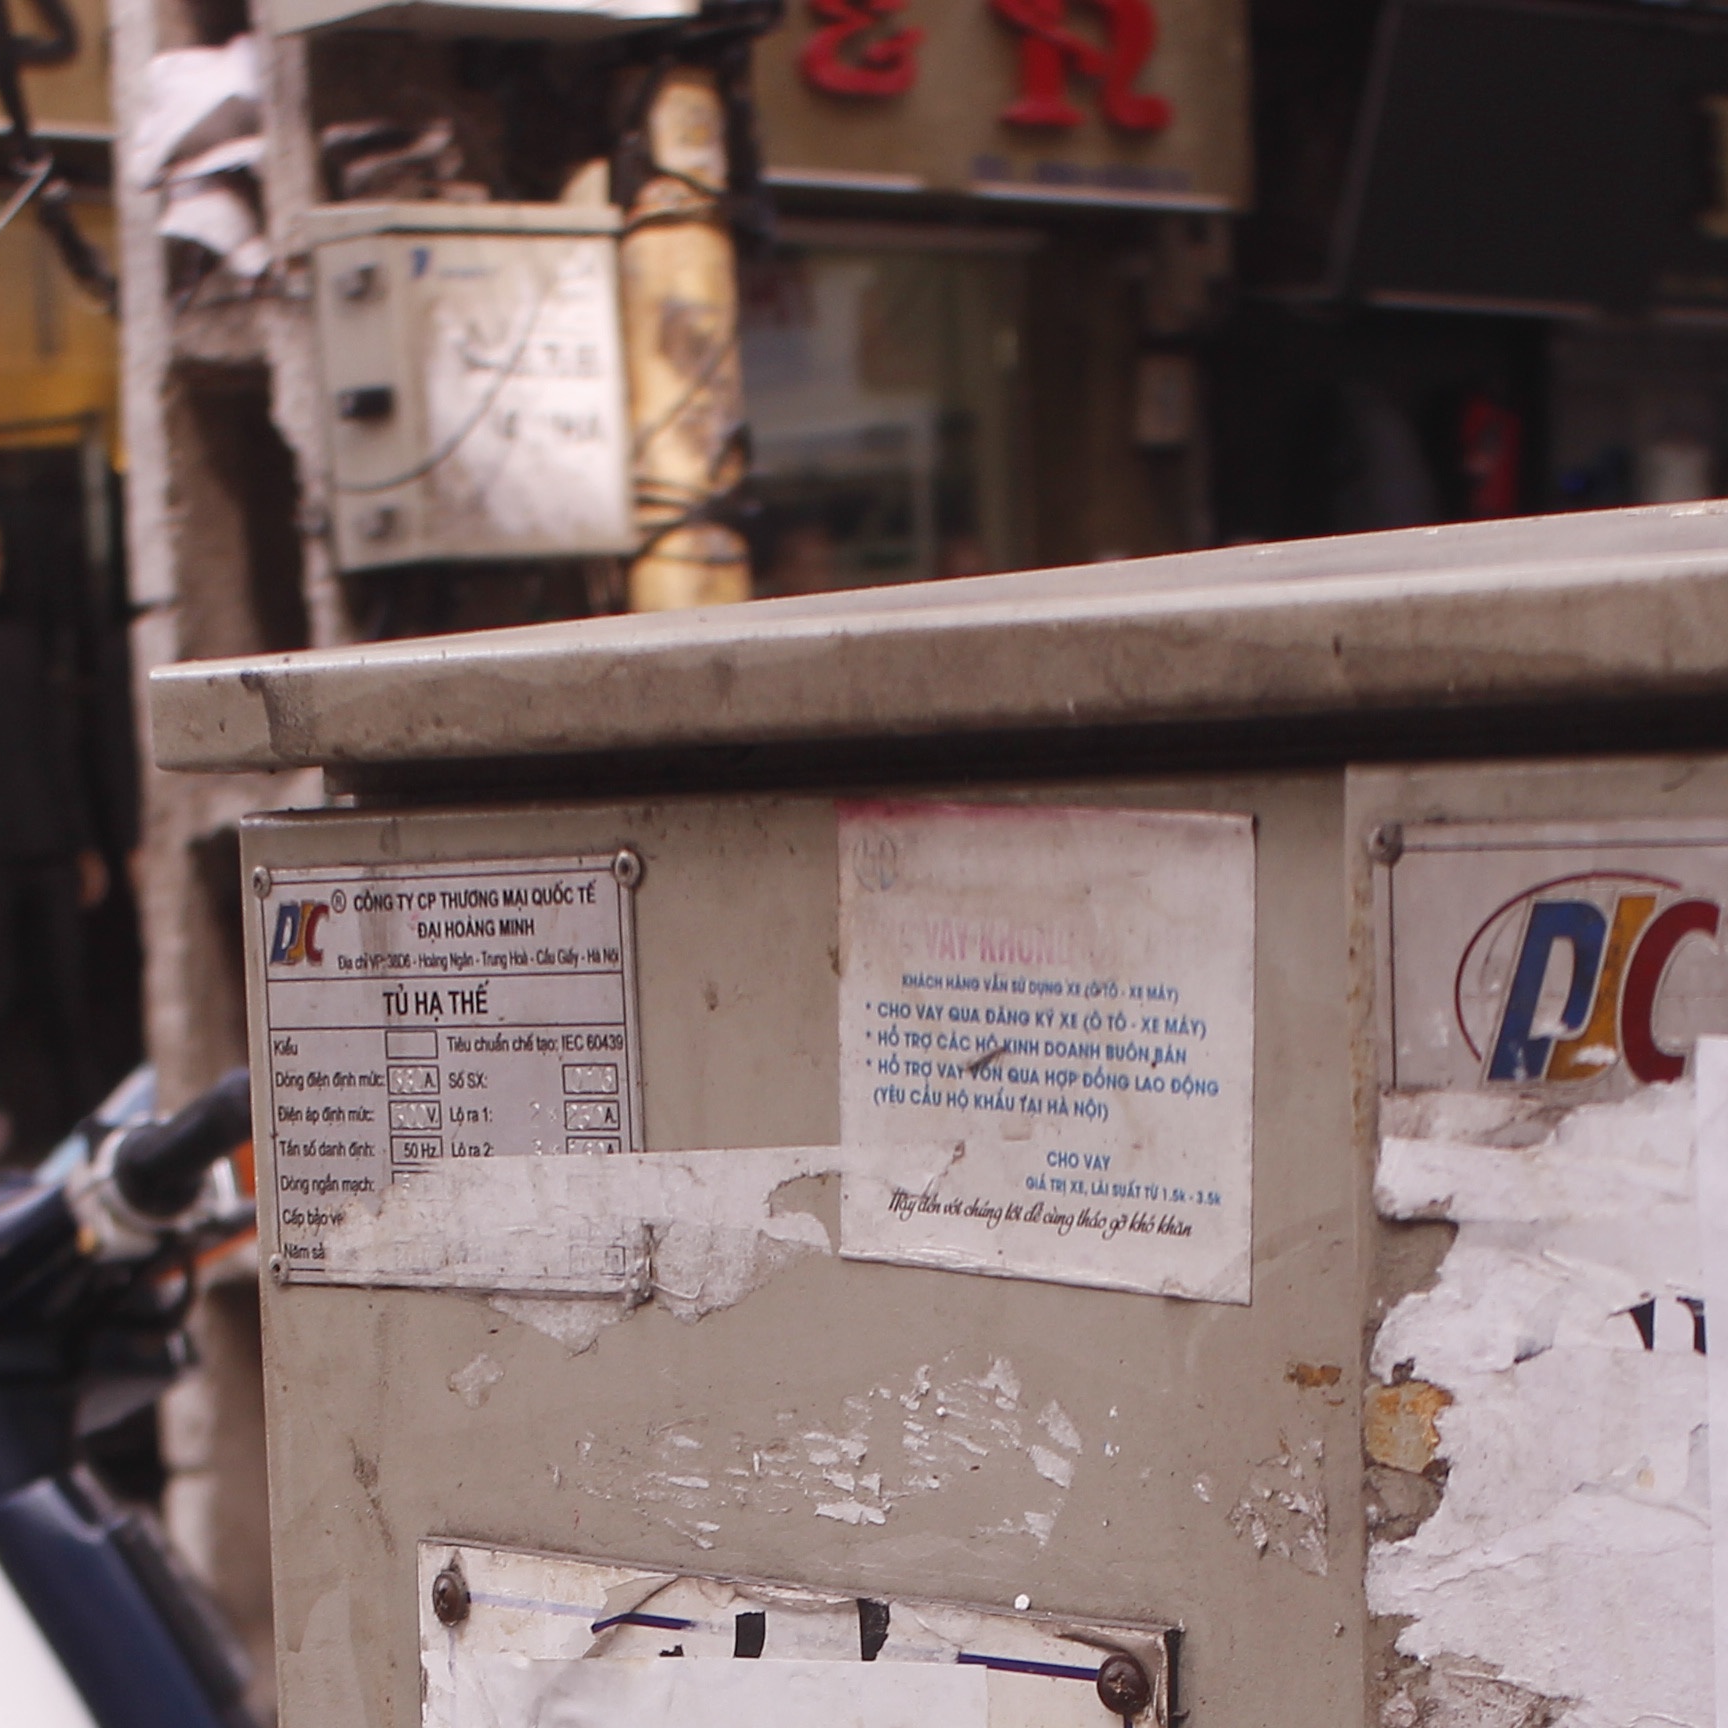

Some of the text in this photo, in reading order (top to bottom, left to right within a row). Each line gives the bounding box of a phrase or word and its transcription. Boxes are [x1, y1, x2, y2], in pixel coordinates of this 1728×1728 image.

[382, 979, 491, 1022] TỦ HẠ THẾ
